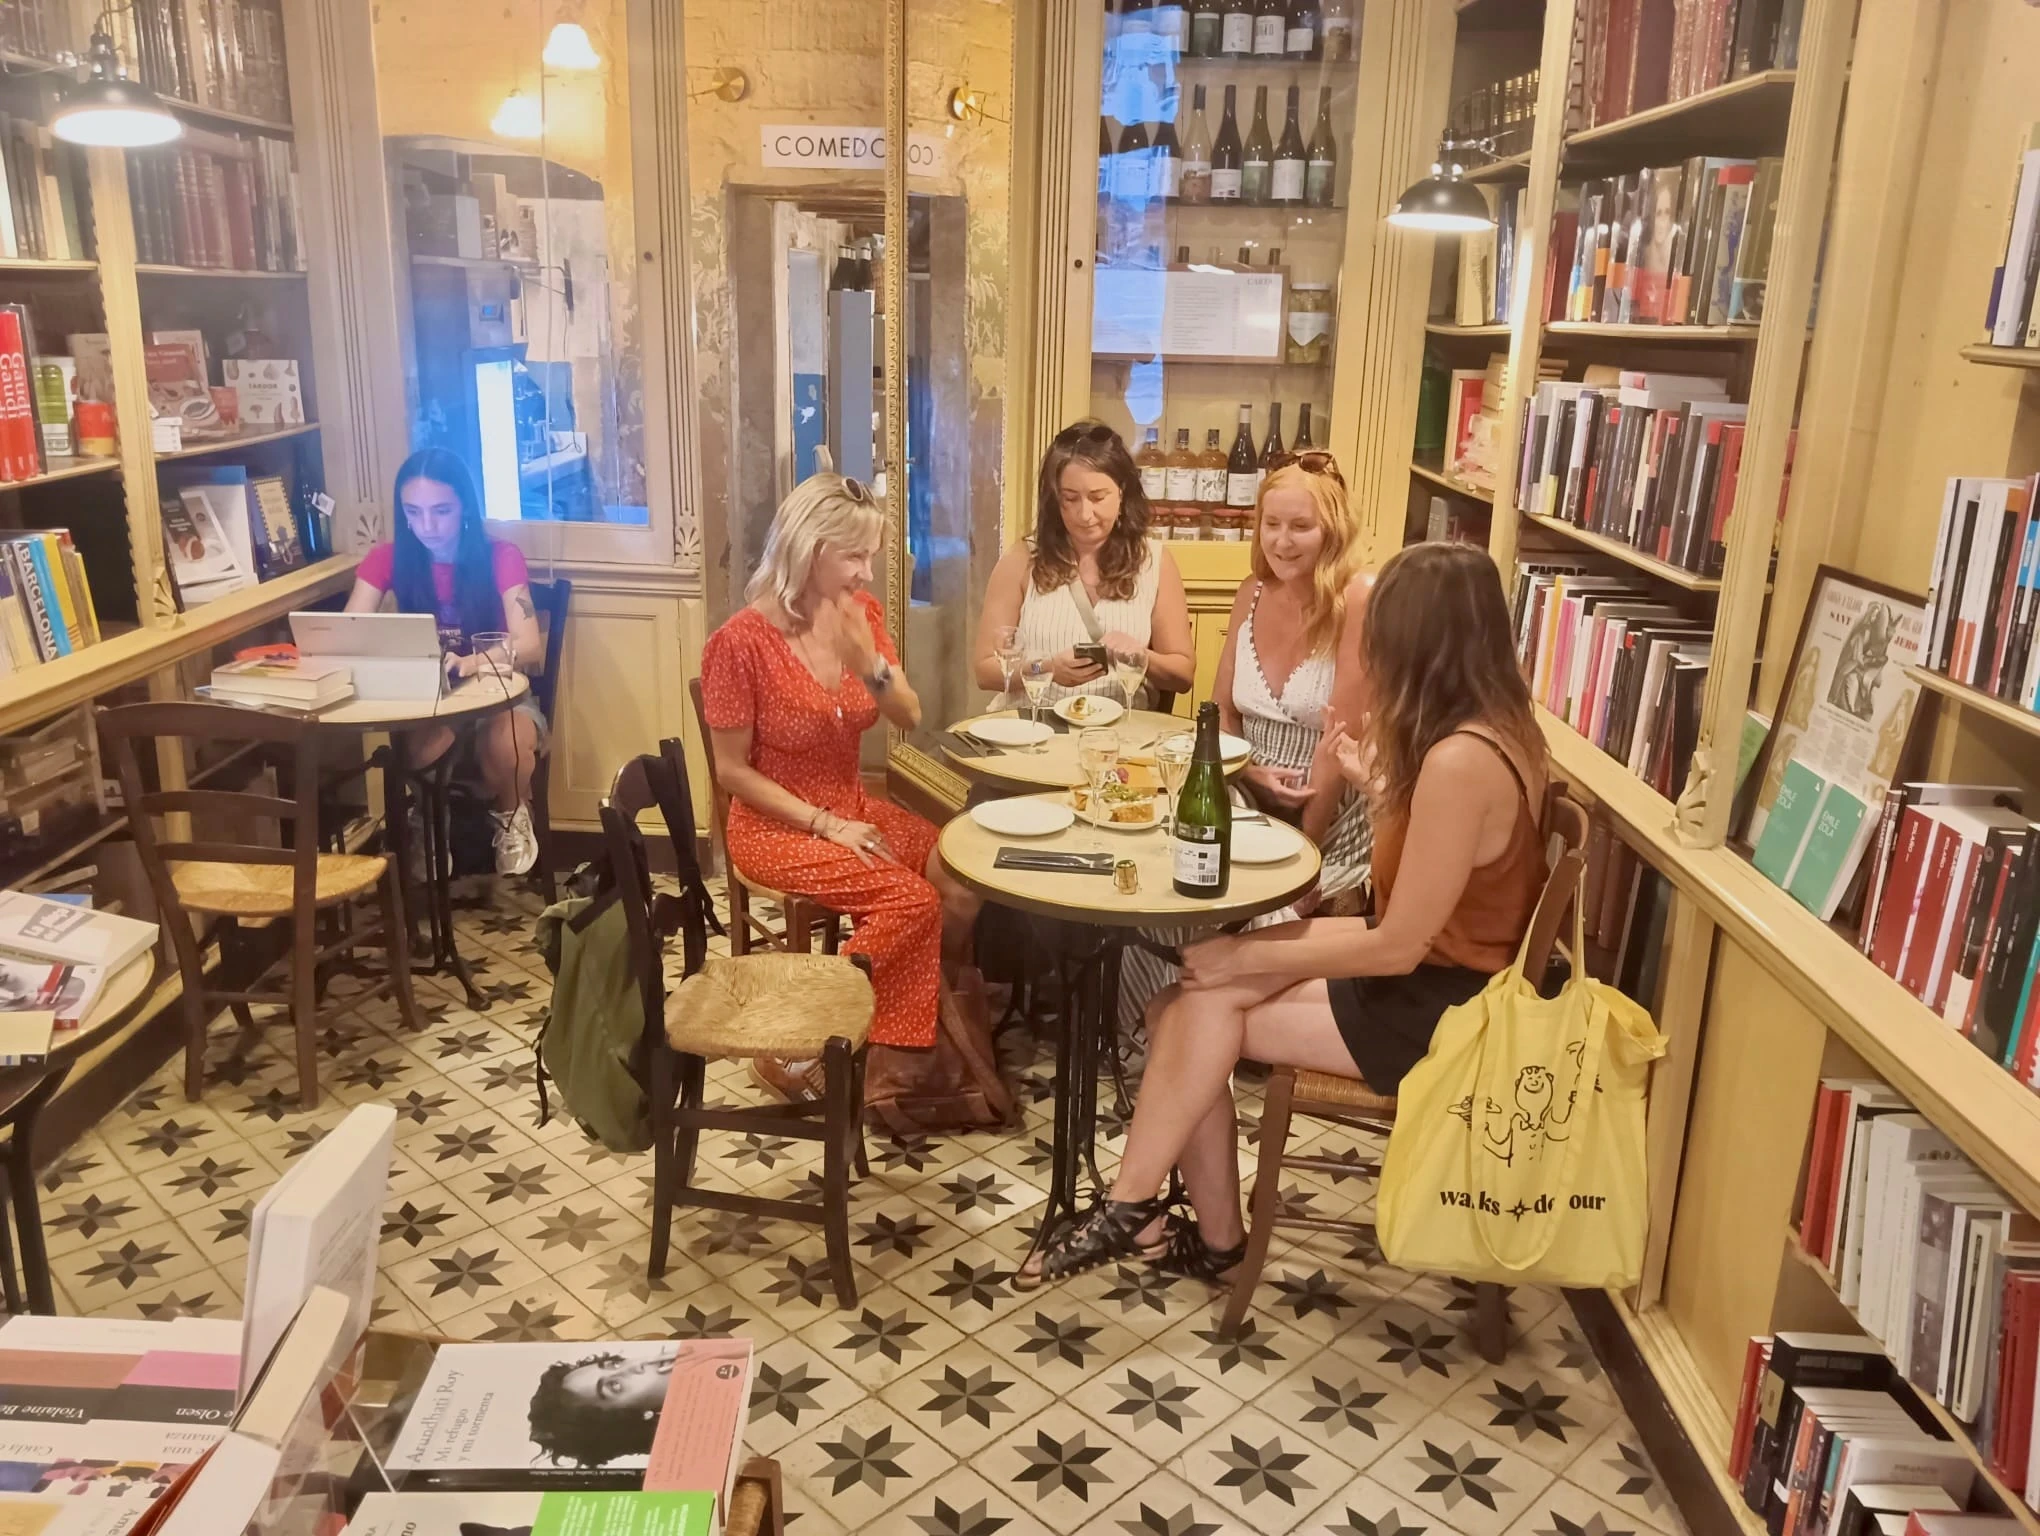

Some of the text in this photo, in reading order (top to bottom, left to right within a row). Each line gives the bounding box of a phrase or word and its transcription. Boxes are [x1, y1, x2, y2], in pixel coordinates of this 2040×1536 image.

[20, 546, 59, 661] BARCELONA
[1908, 821, 1919, 853] BOLAÑO
[1939, 836, 1951, 869] BOLAÑO
[21, 1405, 84, 1418] Violaine
[175, 1407, 221, 1420] Olsen
[406, 1369, 465, 1464] Arundhati Roy
[468, 1392, 495, 1436] tormenta
[433, 1408, 469, 1463] Mi refugio
[462, 1439, 476, 1453] mi
